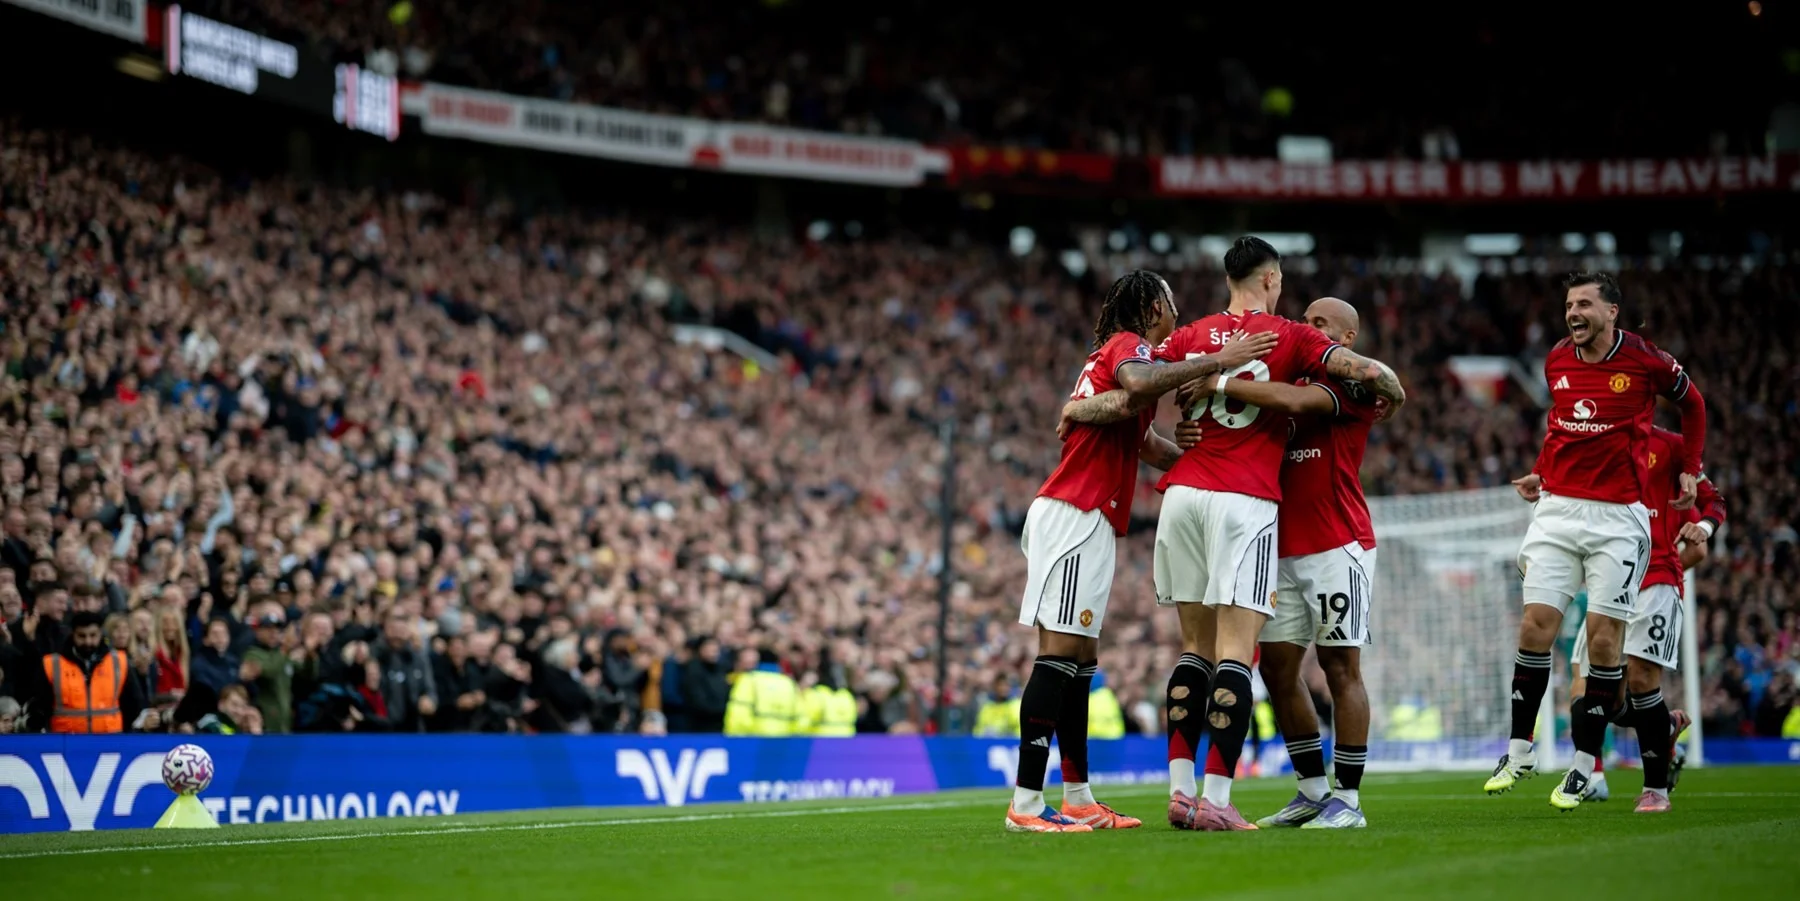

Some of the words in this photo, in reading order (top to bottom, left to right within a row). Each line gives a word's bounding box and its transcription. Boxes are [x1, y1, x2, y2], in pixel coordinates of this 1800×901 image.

[1160, 156, 1449, 196] MANCHESTER
[1461, 159, 1504, 196] IS
[1517, 158, 1583, 196] MY
[1597, 154, 1777, 194] HEAVEN
[1622, 560, 1636, 589] 7
[1317, 592, 1350, 625] 19
[1648, 614, 1667, 642] 8
